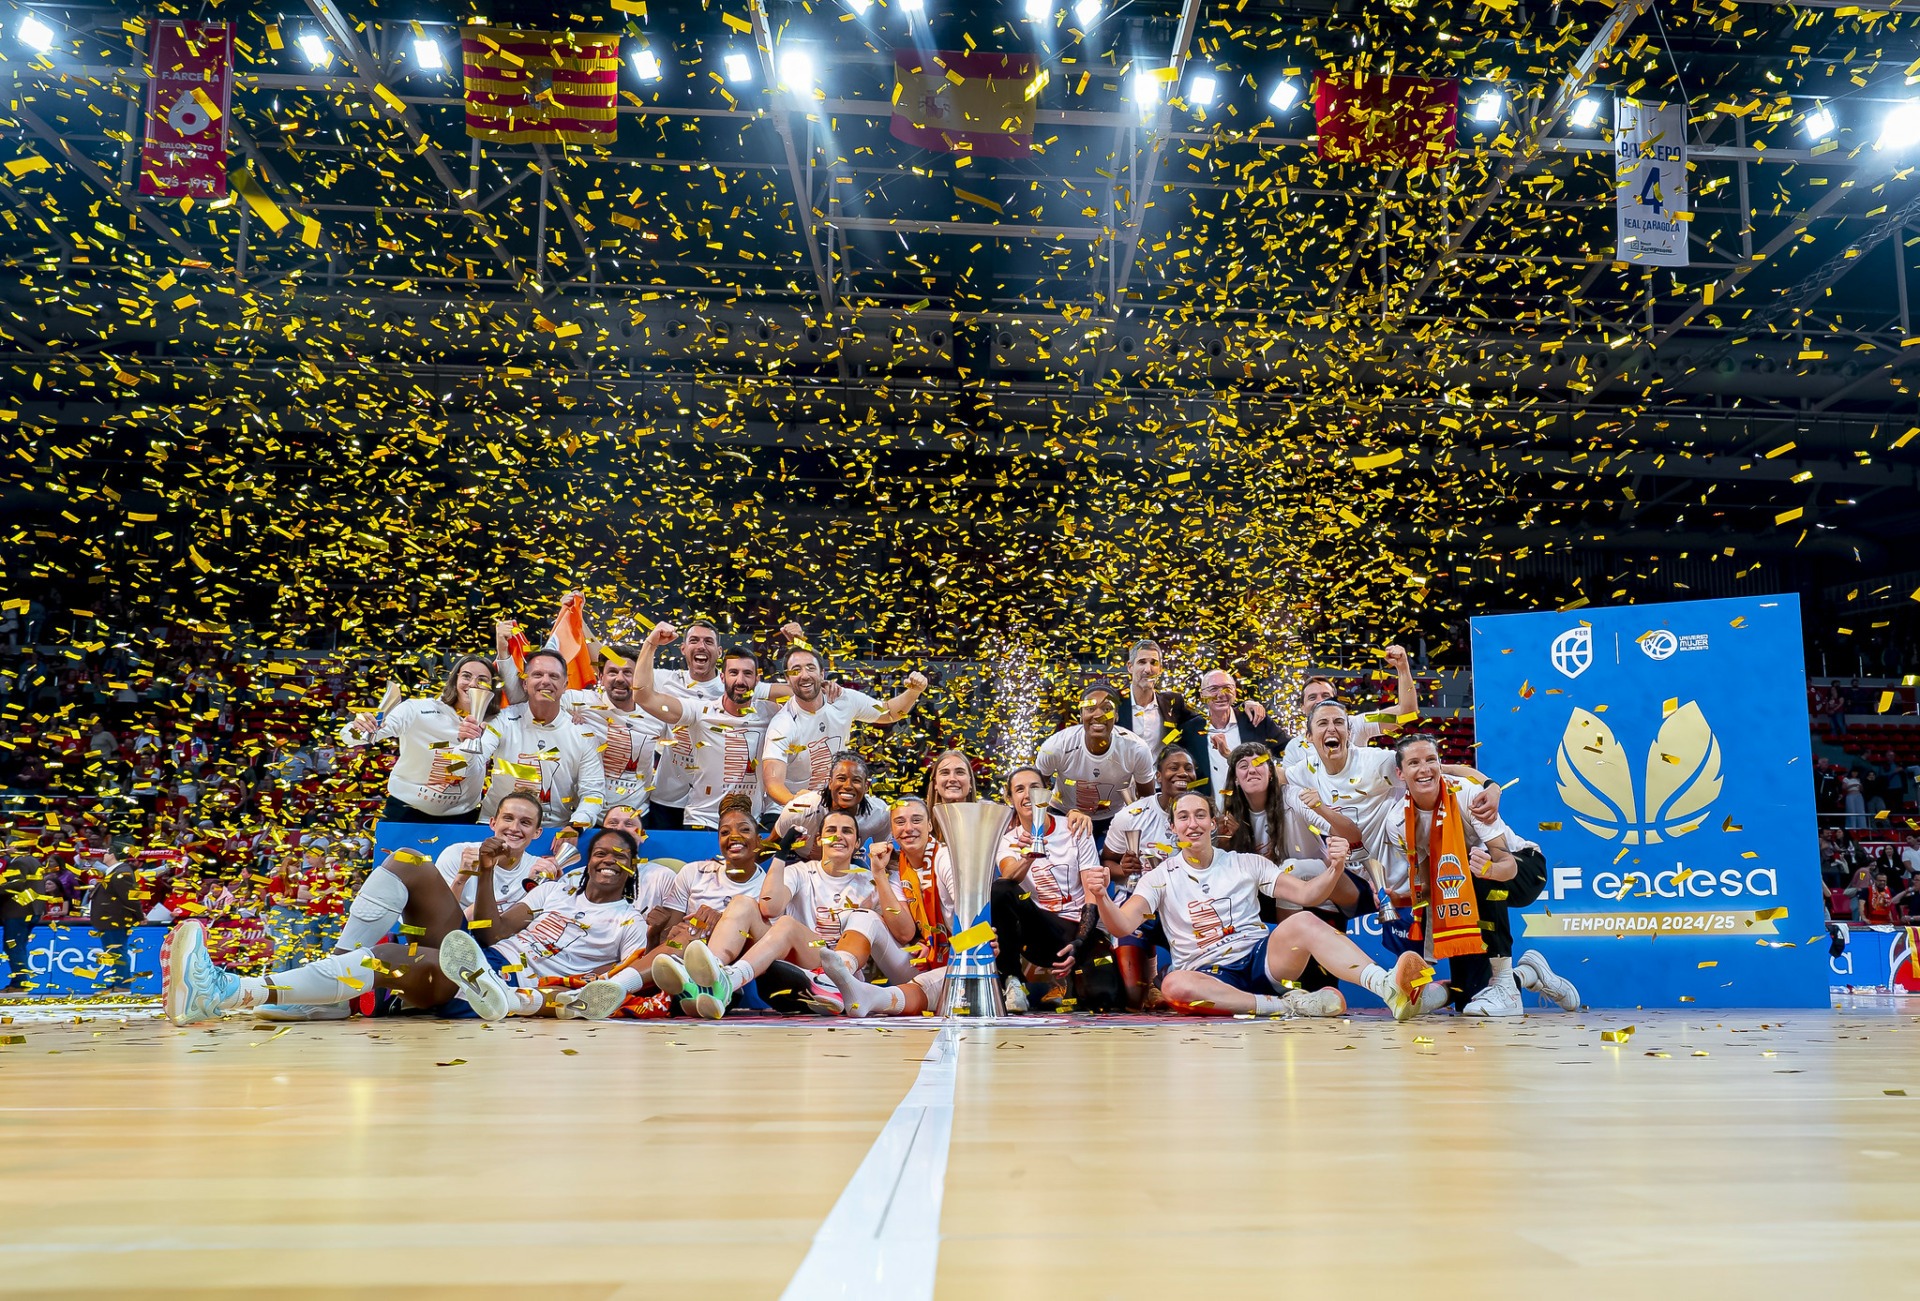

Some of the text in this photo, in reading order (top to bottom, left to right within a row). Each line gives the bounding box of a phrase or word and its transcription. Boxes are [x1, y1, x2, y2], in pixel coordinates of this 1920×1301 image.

[161, 71, 220, 83] F.ARCEA
[1641, 167, 1663, 215] 4
[1642, 220, 1680, 232] ZARAGOZA
[1680, 640, 1709, 648] MUJER
[1592, 862, 1778, 899] endesa
[1436, 903, 1472, 920] VBC
[1562, 914, 1736, 931] TEMPORADA 2024/25
